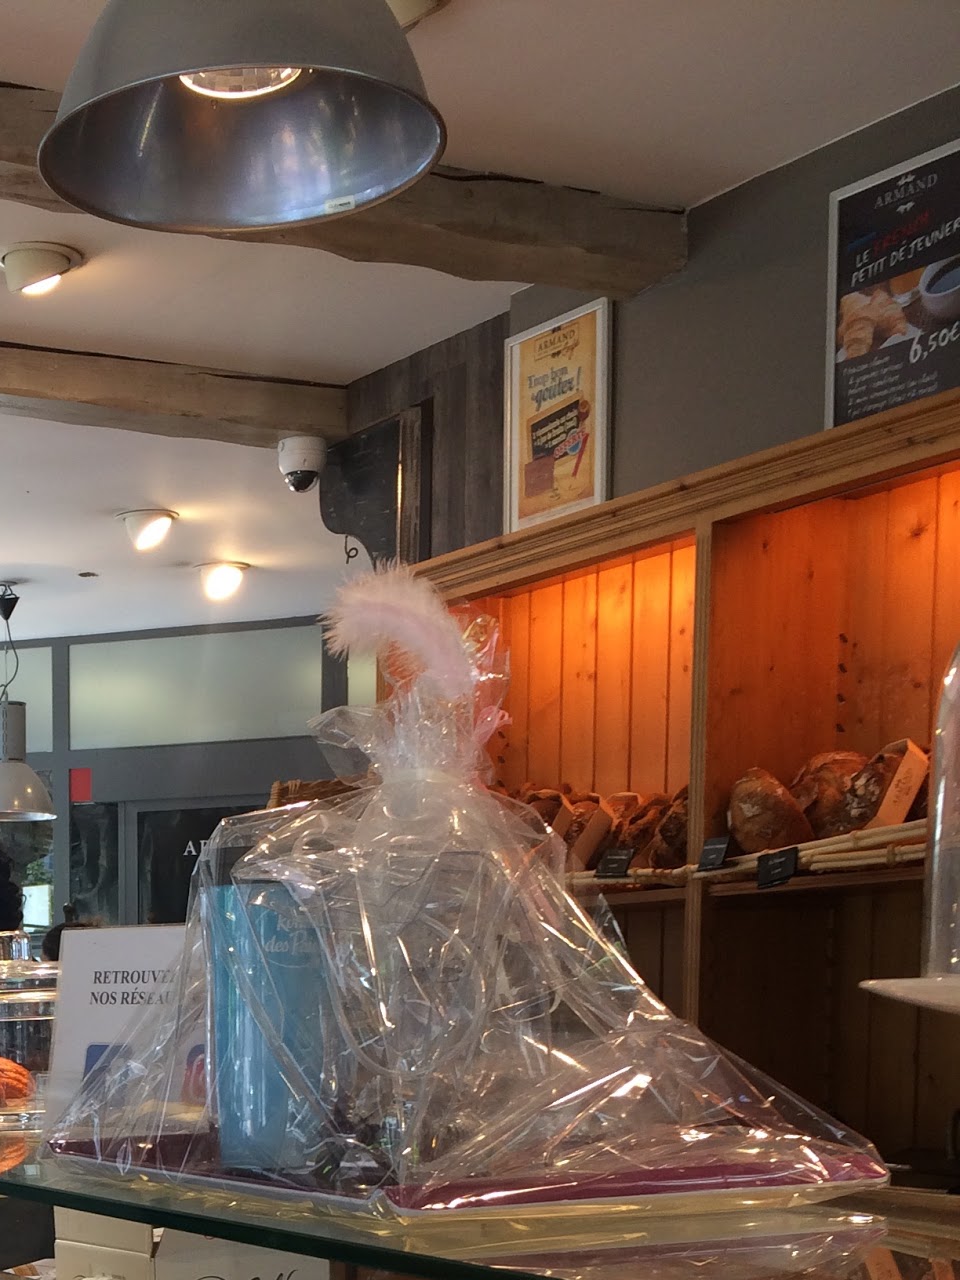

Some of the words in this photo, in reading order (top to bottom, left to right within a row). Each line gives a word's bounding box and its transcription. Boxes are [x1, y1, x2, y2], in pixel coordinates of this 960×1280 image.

[874, 172, 938, 210] ARMAND
[850, 257, 886, 288] PETIT
[889, 215, 960, 268] DÉJEUNER
[855, 248, 871, 268] LE
[537, 328, 575, 353] ARMAND
[89, 991, 118, 1005] NOS
[120, 987, 177, 1005] RÉSEAU
